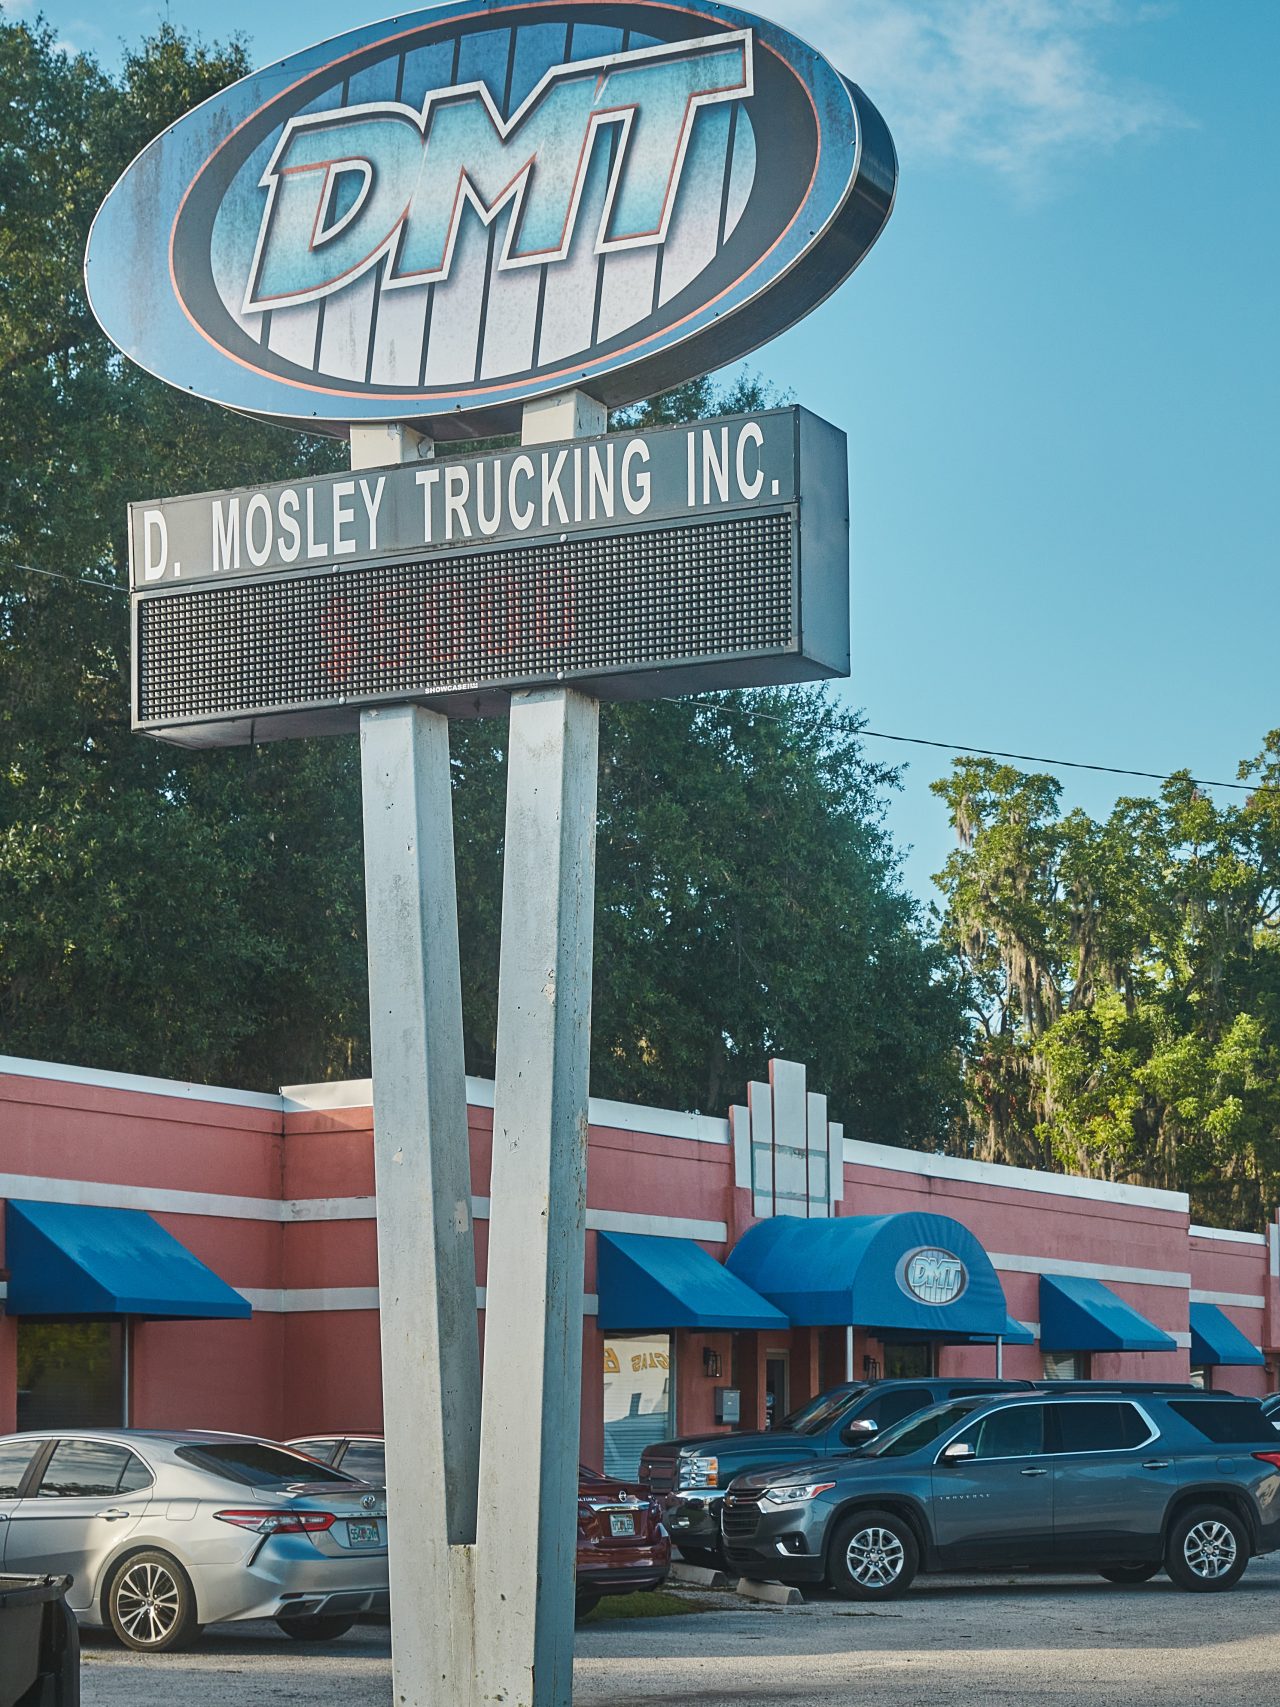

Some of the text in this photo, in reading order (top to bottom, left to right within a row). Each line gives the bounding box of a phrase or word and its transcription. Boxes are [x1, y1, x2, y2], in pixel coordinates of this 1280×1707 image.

[242, 28, 754, 314] DMT
[144, 422, 779, 580] D. MOSLEY TRUCKING INC.
[911, 1256, 961, 1289] DMT
